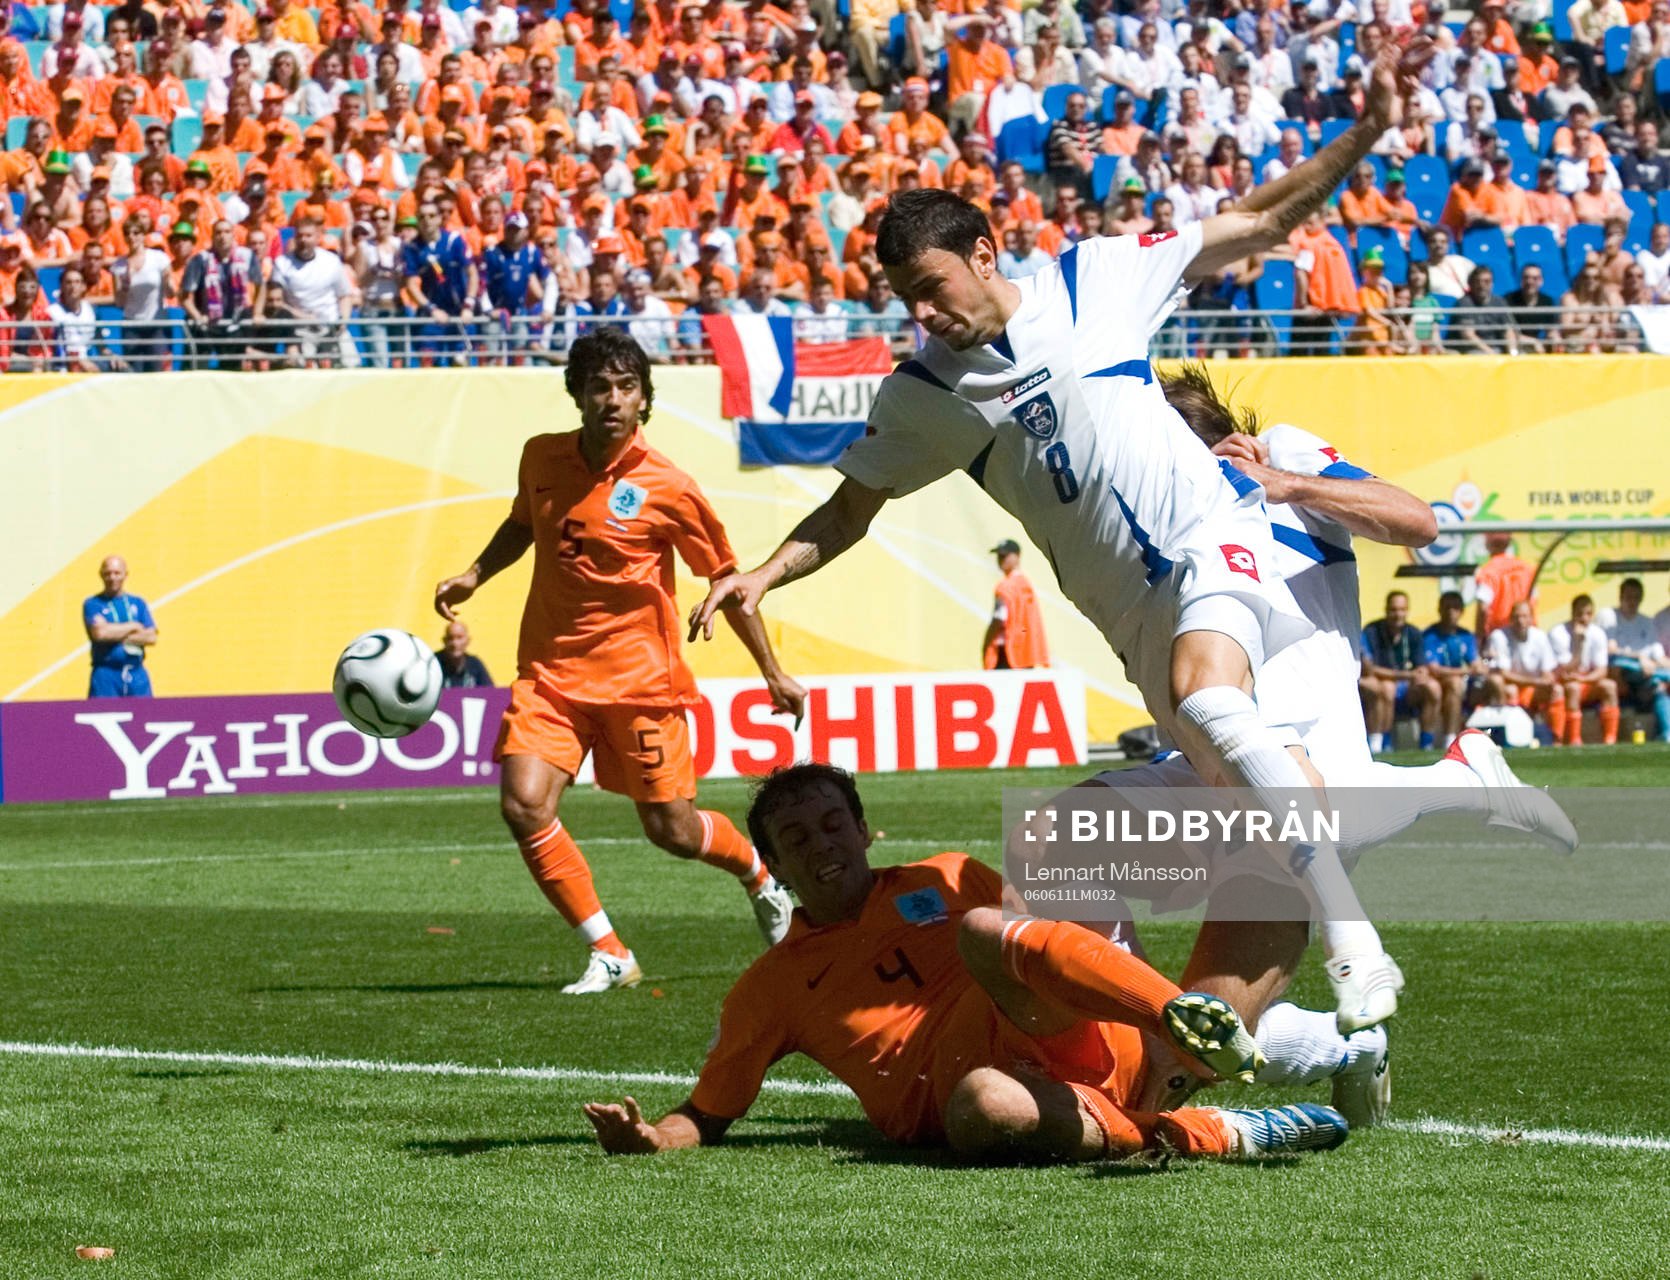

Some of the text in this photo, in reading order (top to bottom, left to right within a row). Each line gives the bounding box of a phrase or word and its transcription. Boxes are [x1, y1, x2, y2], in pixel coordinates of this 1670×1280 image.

[1014, 371, 1049, 396] lotto
[1046, 441, 1079, 504] 8
[1529, 489, 1654, 505] FIFA WORLD CUP
[559, 518, 586, 559] 5
[75, 697, 487, 799] YAHOO!
[637, 729, 664, 770] 5
[873, 947, 925, 989] 4
